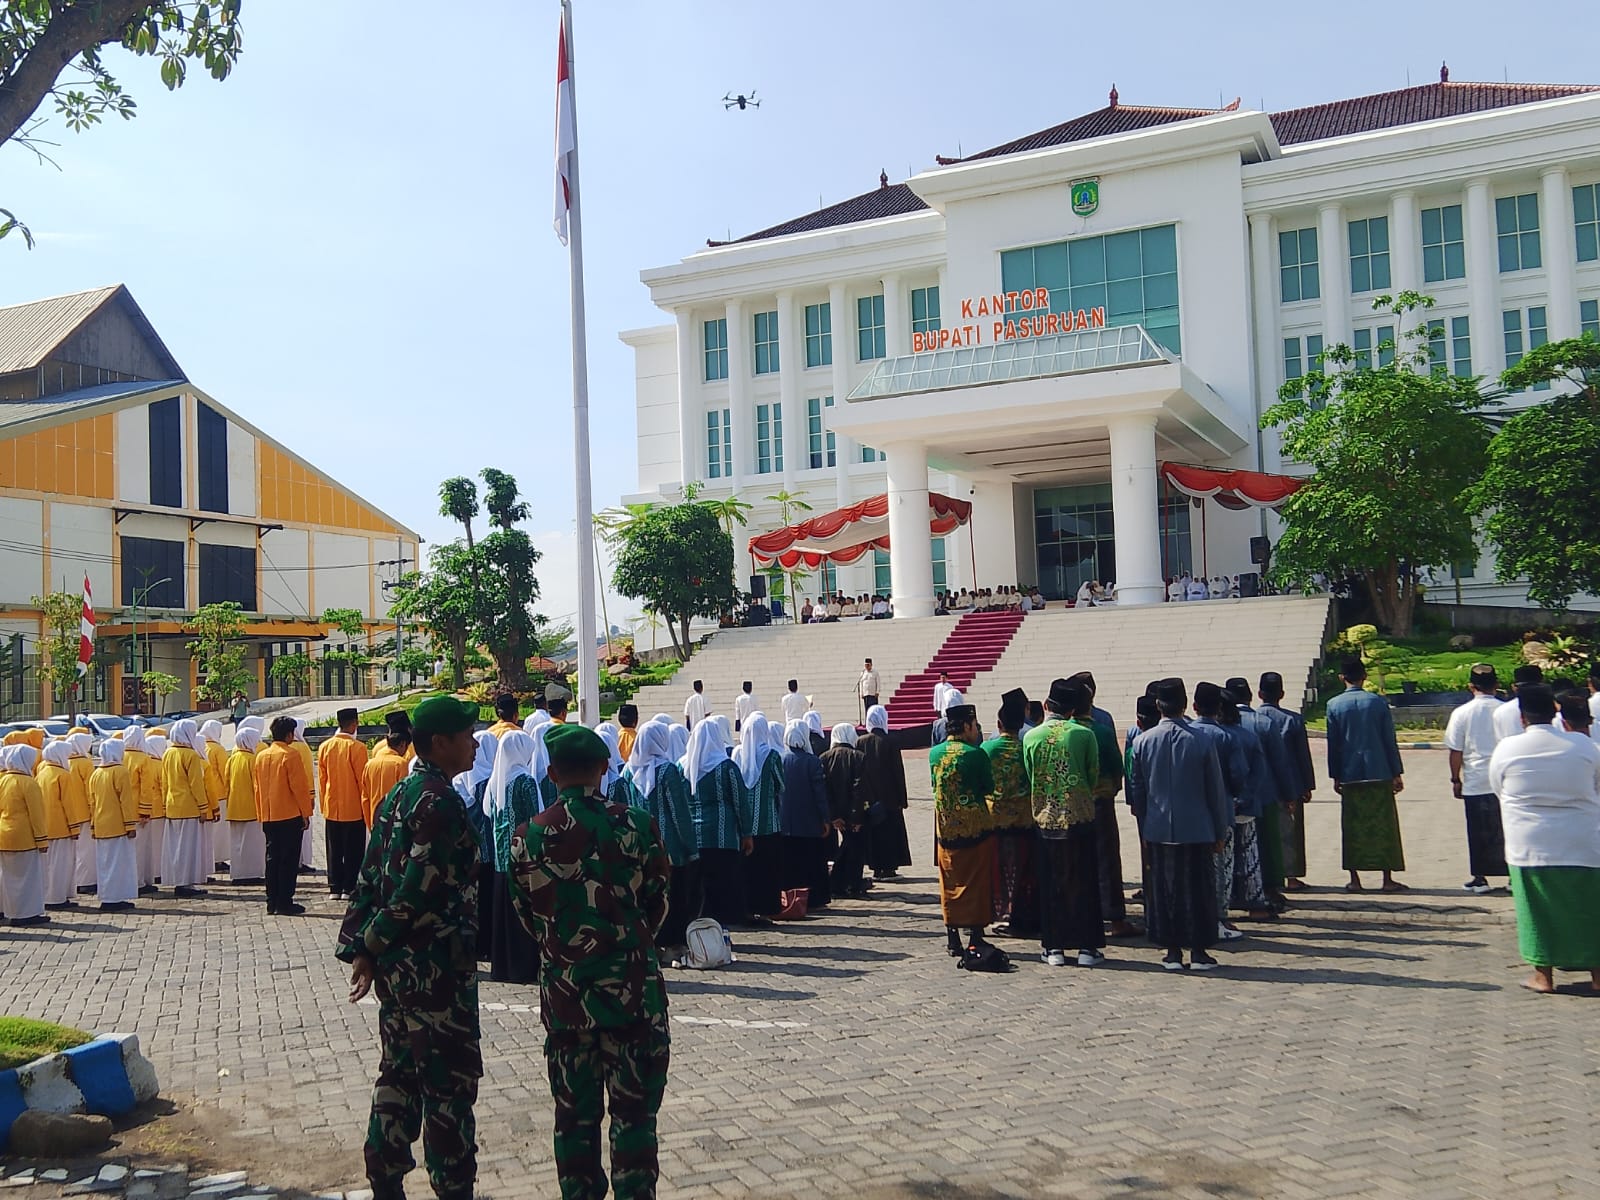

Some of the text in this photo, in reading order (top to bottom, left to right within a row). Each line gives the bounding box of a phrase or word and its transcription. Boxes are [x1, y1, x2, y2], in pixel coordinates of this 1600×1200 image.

[961, 287, 1048, 318] KANTOR
[913, 307, 1104, 352] BUPATI PASURUAN
